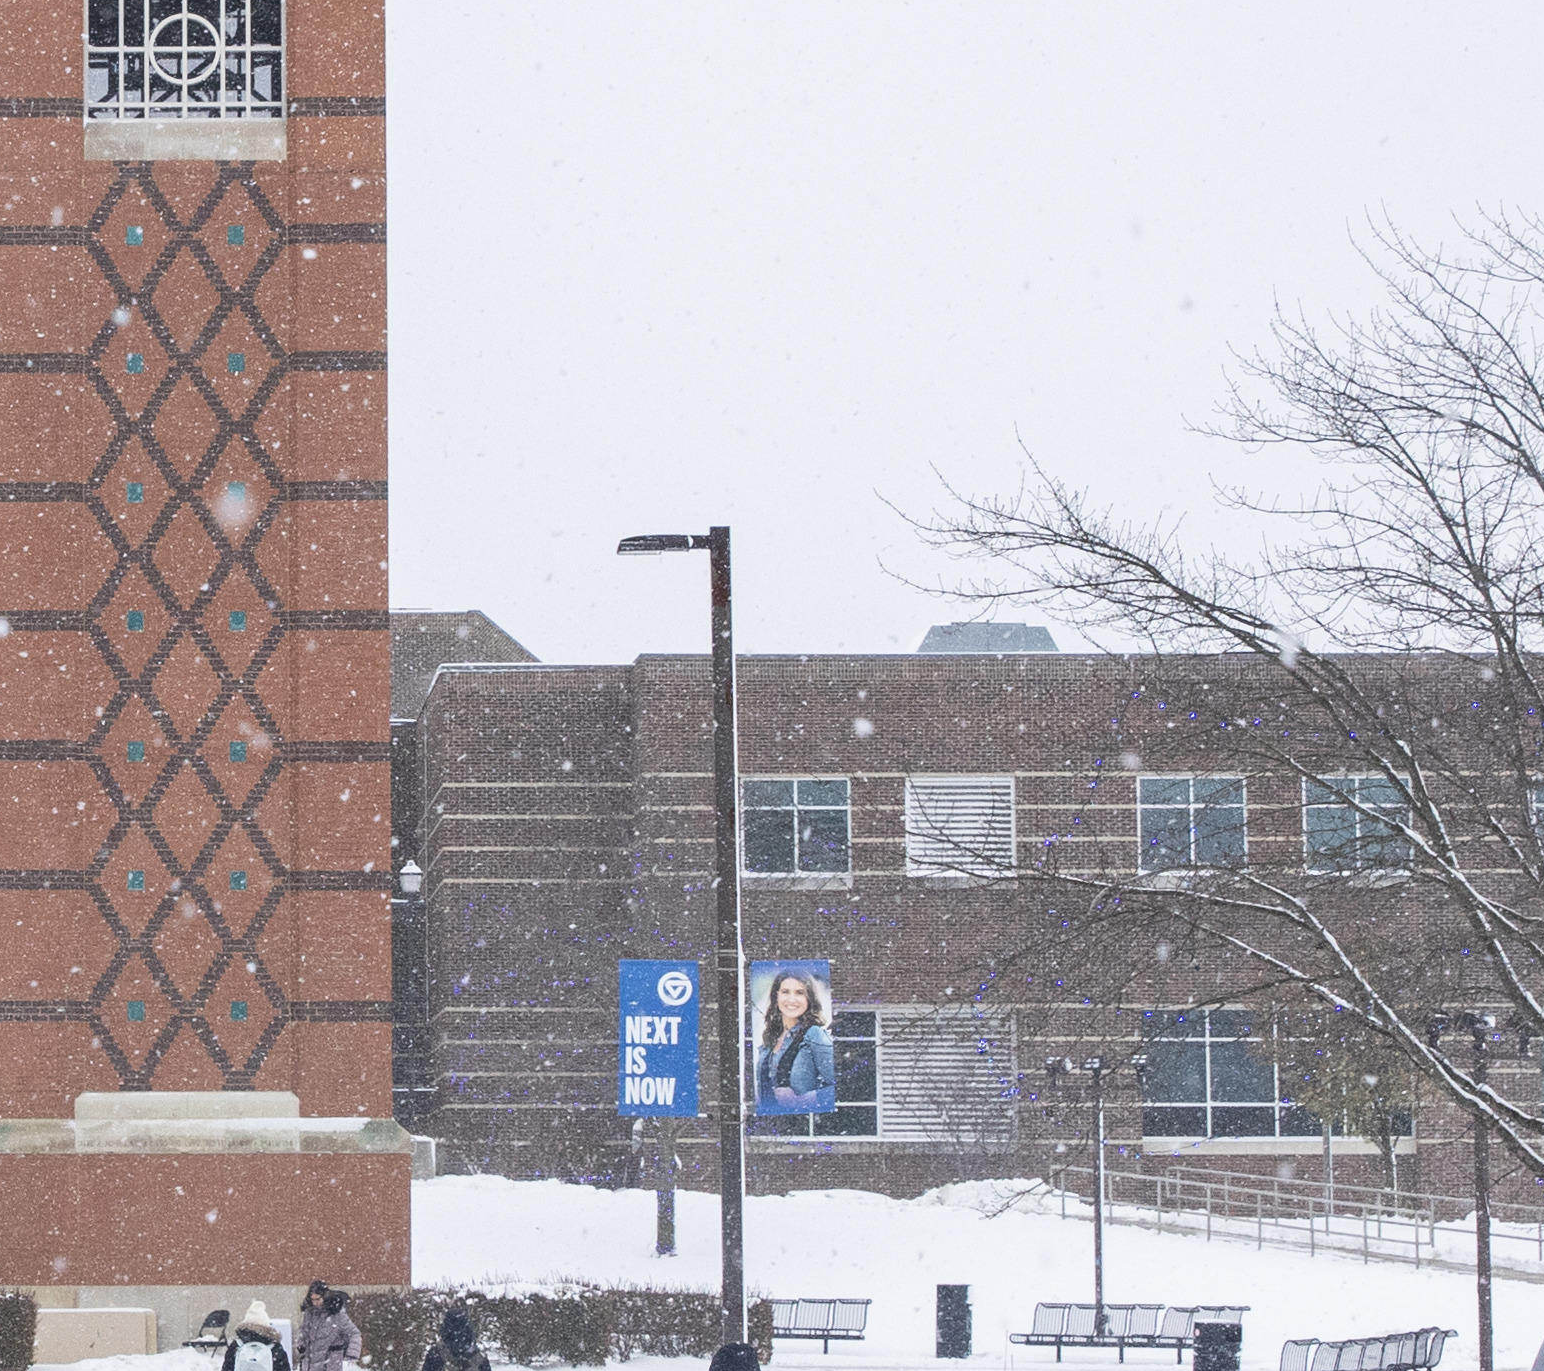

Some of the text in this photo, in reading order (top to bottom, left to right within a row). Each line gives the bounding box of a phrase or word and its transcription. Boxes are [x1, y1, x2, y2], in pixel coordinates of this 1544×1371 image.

[625, 1016, 682, 1044] NEXT
[625, 1046, 647, 1075] IS
[625, 1076, 676, 1105] NOW
